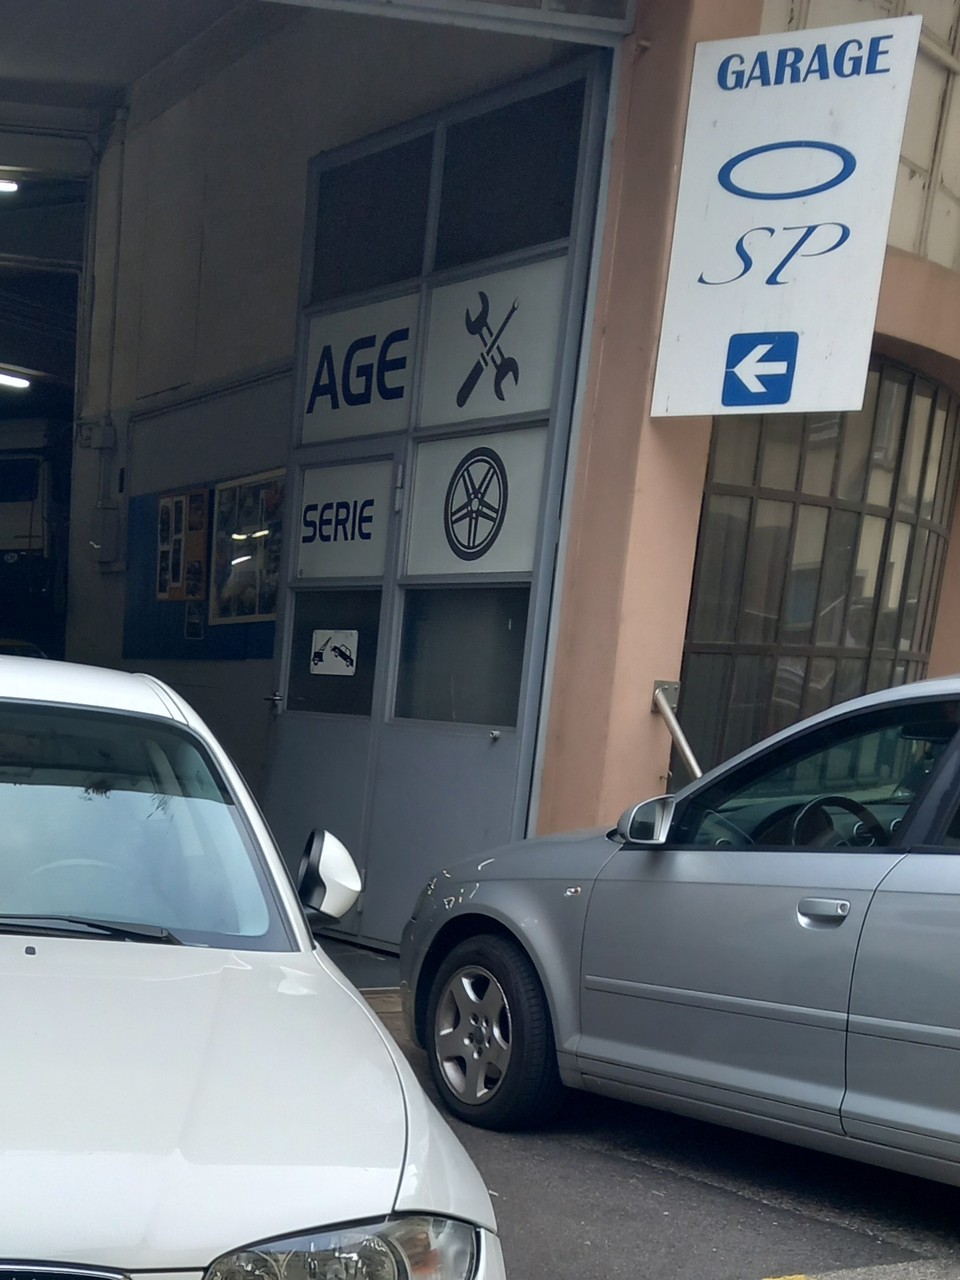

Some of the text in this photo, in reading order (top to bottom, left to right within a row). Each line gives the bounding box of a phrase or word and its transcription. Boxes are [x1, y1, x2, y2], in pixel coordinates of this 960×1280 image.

[717, 34, 894, 91] GARAGE
[697, 221, 851, 286] SP
[306, 327, 410, 414] AGE
[302, 499, 375, 543] SERIE
